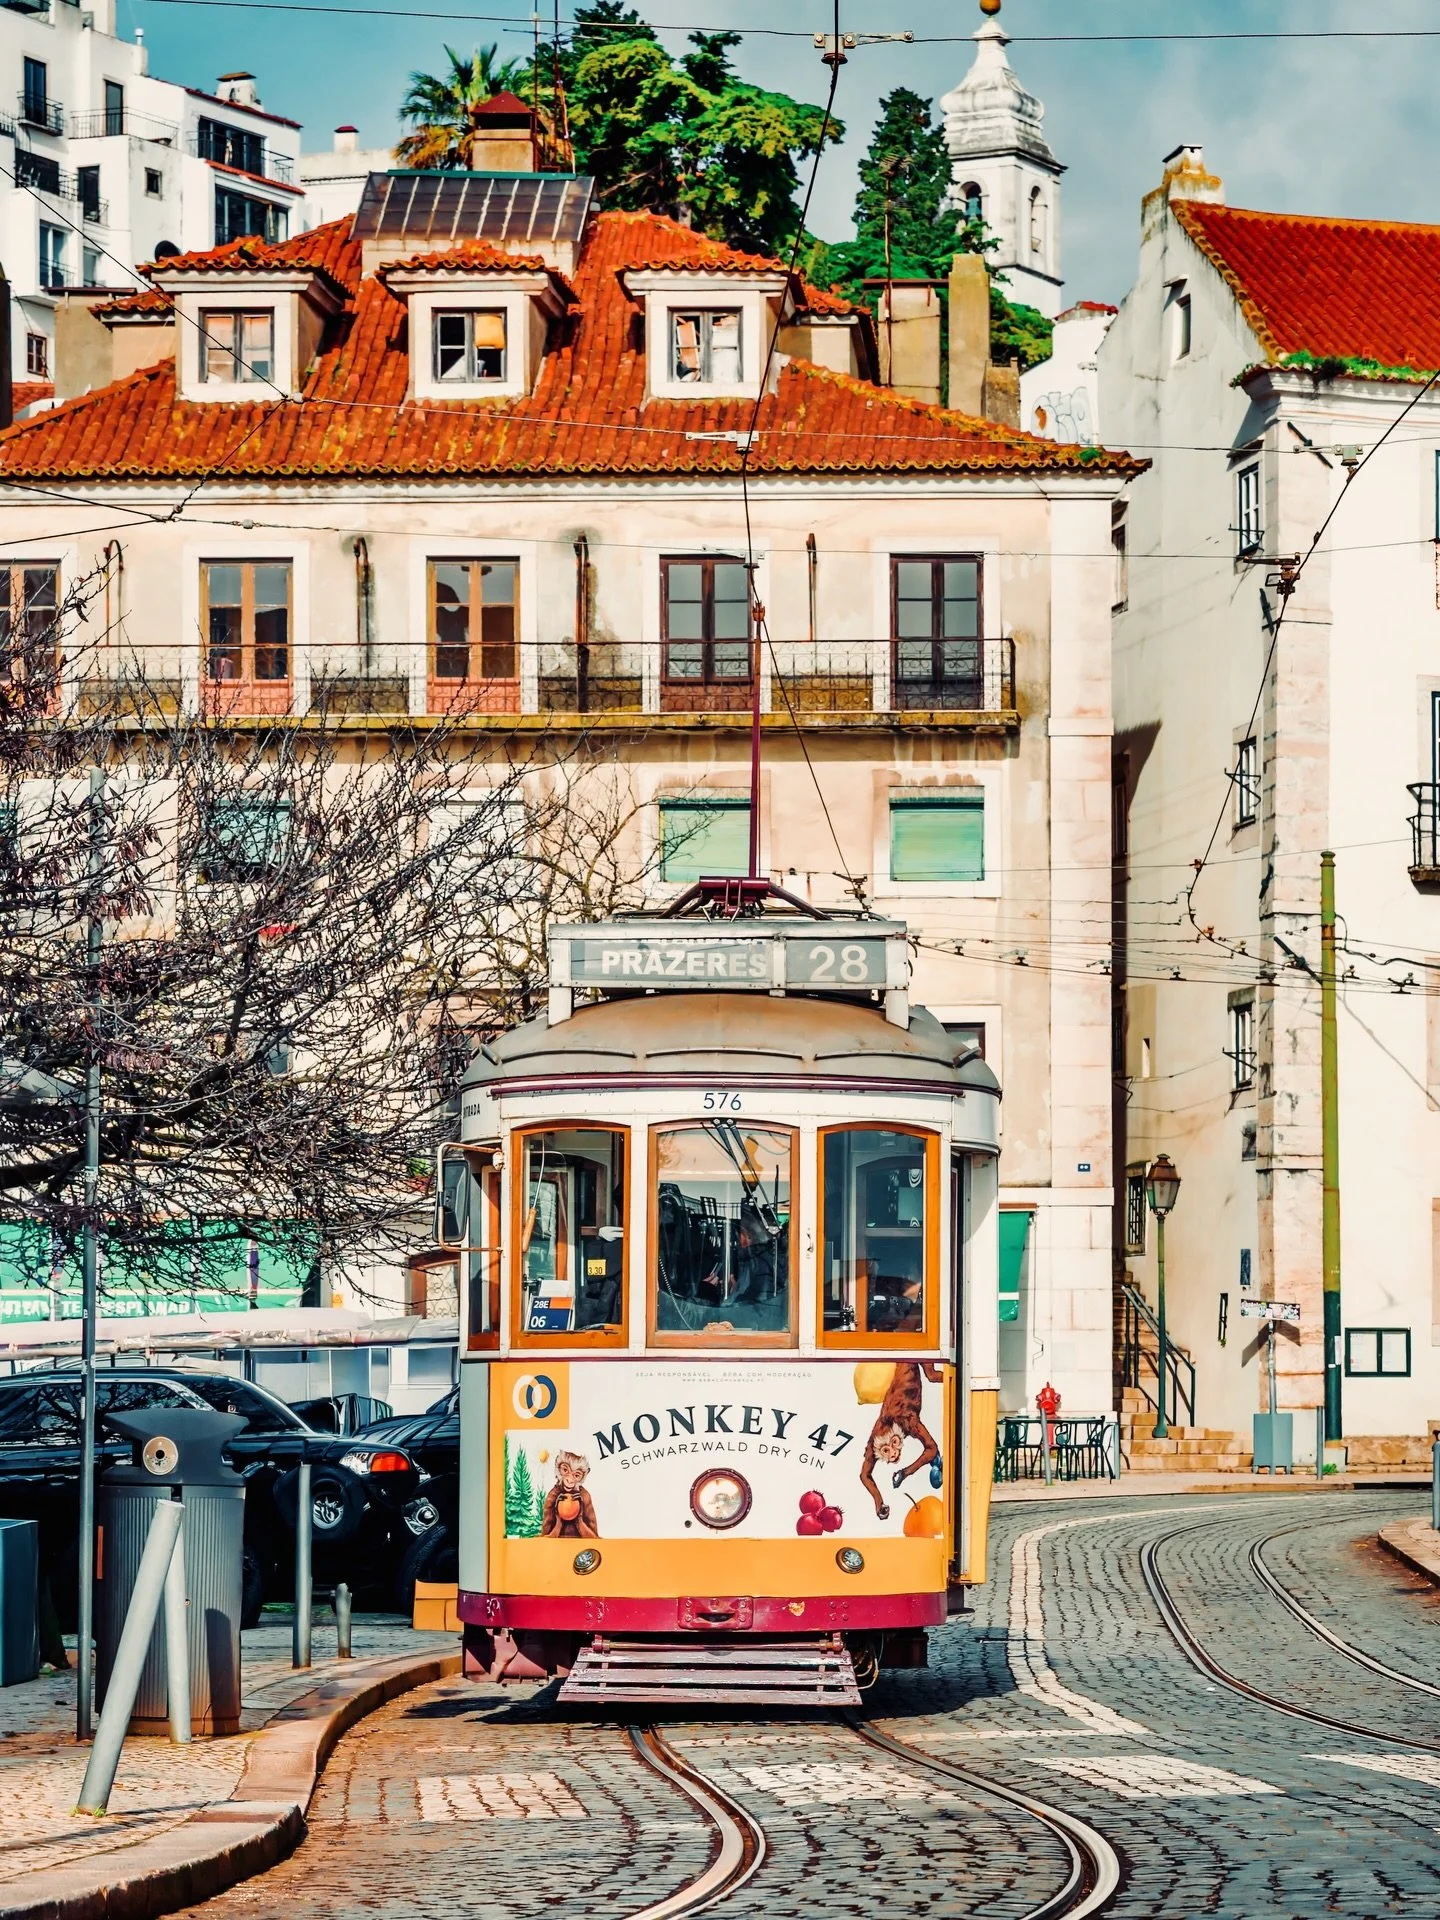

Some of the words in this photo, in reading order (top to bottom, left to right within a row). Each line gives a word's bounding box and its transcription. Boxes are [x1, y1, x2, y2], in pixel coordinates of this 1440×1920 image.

[601, 950, 768, 977] PRAZERES
[809, 945, 870, 983] 28
[703, 1092, 742, 1111] 576
[533, 1300, 549, 1309] 28E
[530, 1316, 546, 1328] 06
[592, 1404, 798, 1460] MONKEY
[807, 1423, 854, 1457] 47
[620, 1441, 748, 1470] SCHWARZWALD
[758, 1443, 791, 1459] DRY
[798, 1453, 826, 1470] GIN
